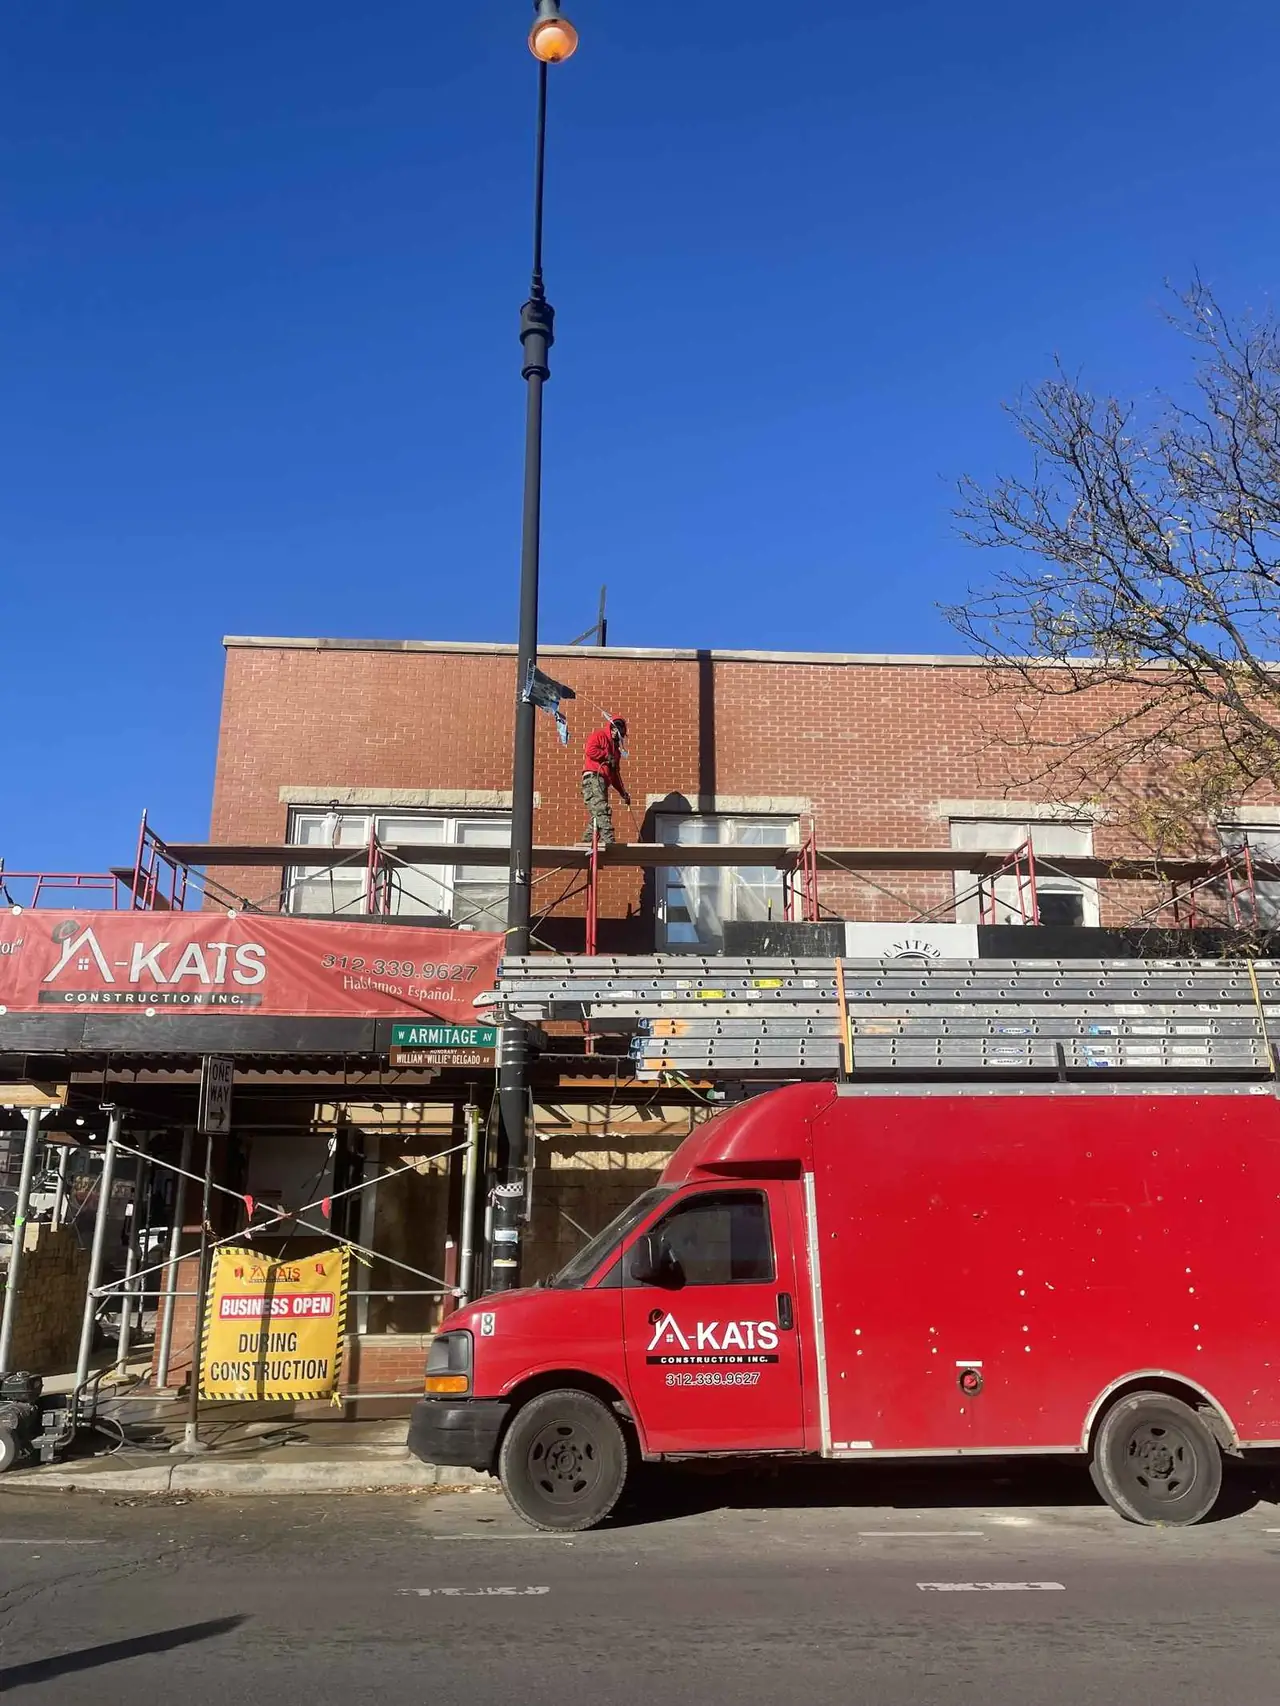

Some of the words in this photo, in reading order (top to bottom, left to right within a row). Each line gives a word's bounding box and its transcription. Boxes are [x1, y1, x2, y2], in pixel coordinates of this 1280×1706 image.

[884, 940, 941, 958] UNITED
[321, 953, 478, 982] 312.339.9627
[343, 975, 403, 996] Hablamos
[408, 985, 465, 1002] Español...
[64, 993, 202, 1004] CONSTRUCTION
[211, 994, 244, 1004] INC.
[398, 1031, 404, 1040] W
[408, 1028, 478, 1045] ARMITAGE
[482, 1033, 492, 1042] AV
[396, 1053, 423, 1064] WILLIAM
[424, 1053, 451, 1065] "WILLIE"
[452, 1054, 481, 1065] DELGADO
[212, 1063, 231, 1082] ONE
[210, 1084, 229, 1104] WAY
[221, 1298, 289, 1316] BUSINESS
[292, 1297, 331, 1315] OPEN
[238, 1332, 298, 1353] DURING
[660, 1355, 743, 1364] CONSTRUCTION
[747, 1355, 768, 1363] INC.
[210, 1359, 328, 1381] CONSTRUCTION
[665, 1372, 760, 1387] 312.339.9627
